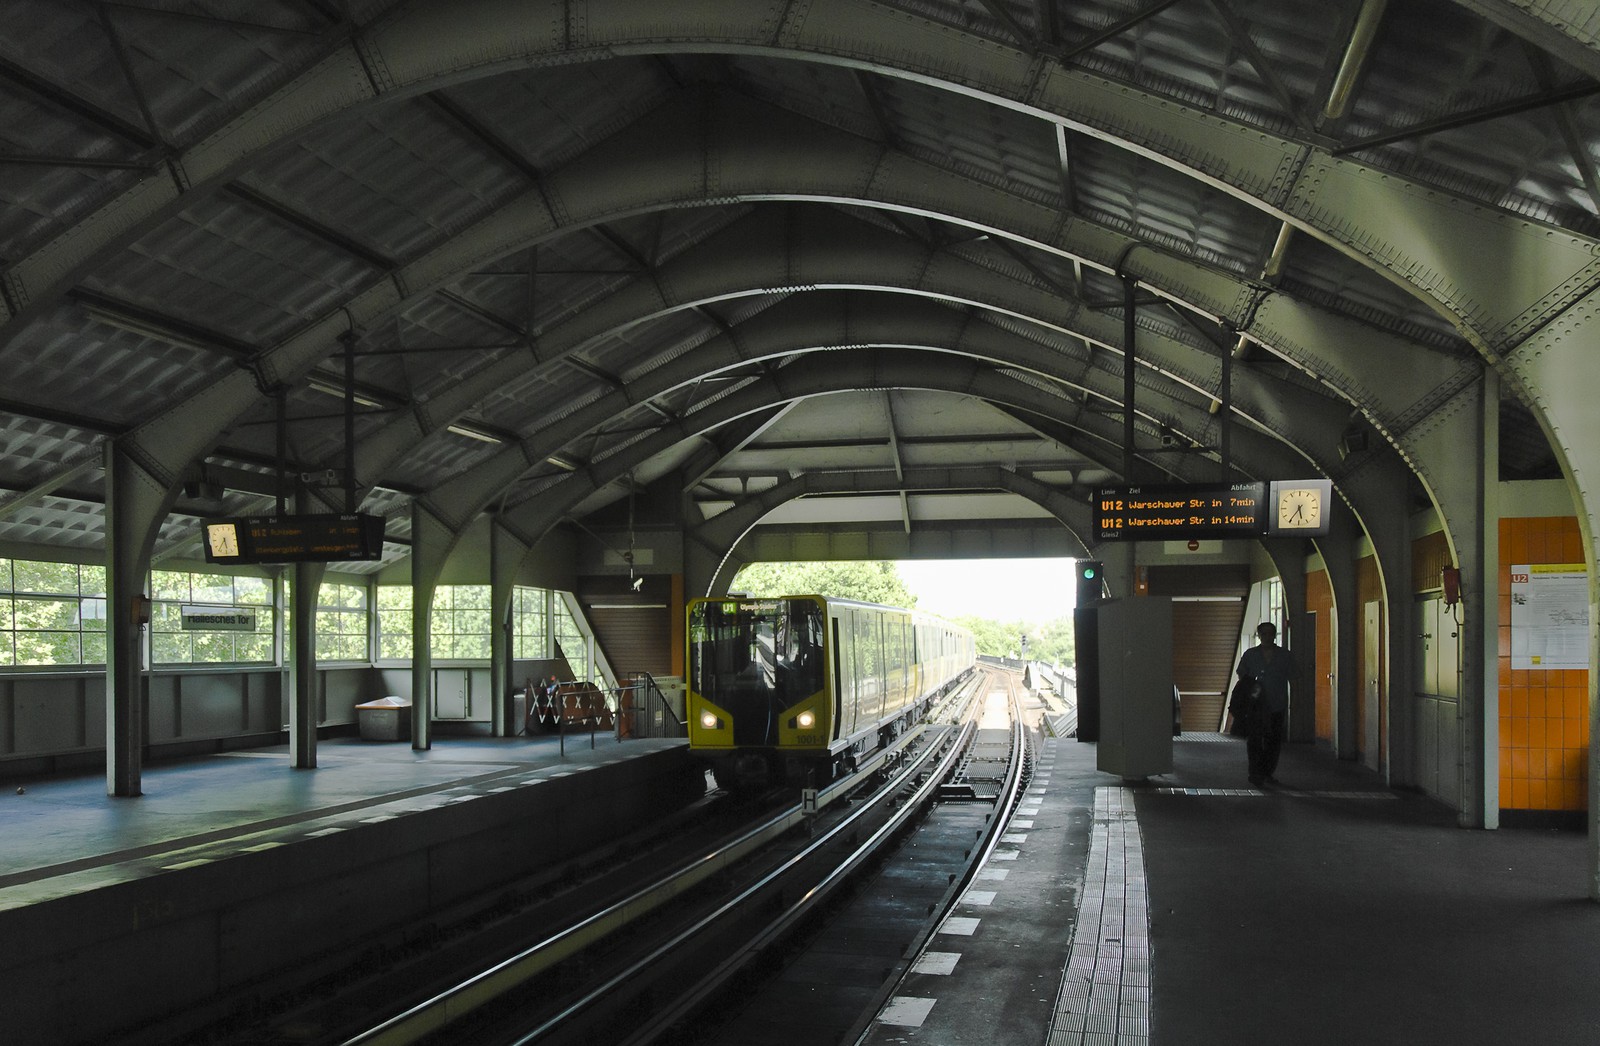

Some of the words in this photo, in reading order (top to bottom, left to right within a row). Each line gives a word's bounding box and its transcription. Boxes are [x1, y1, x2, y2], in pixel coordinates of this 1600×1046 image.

[1101, 488, 1116, 496] Linie
[1101, 500, 1123, 511] U12
[1128, 500, 1185, 510] Warschauer
[1189, 499, 1206, 508] Str.
[1211, 498, 1222, 507] in
[1101, 518, 1123, 529] U12
[1128, 518, 1185, 527] Warschauer
[1189, 516, 1206, 525] Str.
[1211, 516, 1222, 525] in
[1513, 574, 1527, 583] U2
[187, 613, 235, 624] Hallesches
[237, 614, 250, 624] Tor
[804, 792, 815, 810] H
